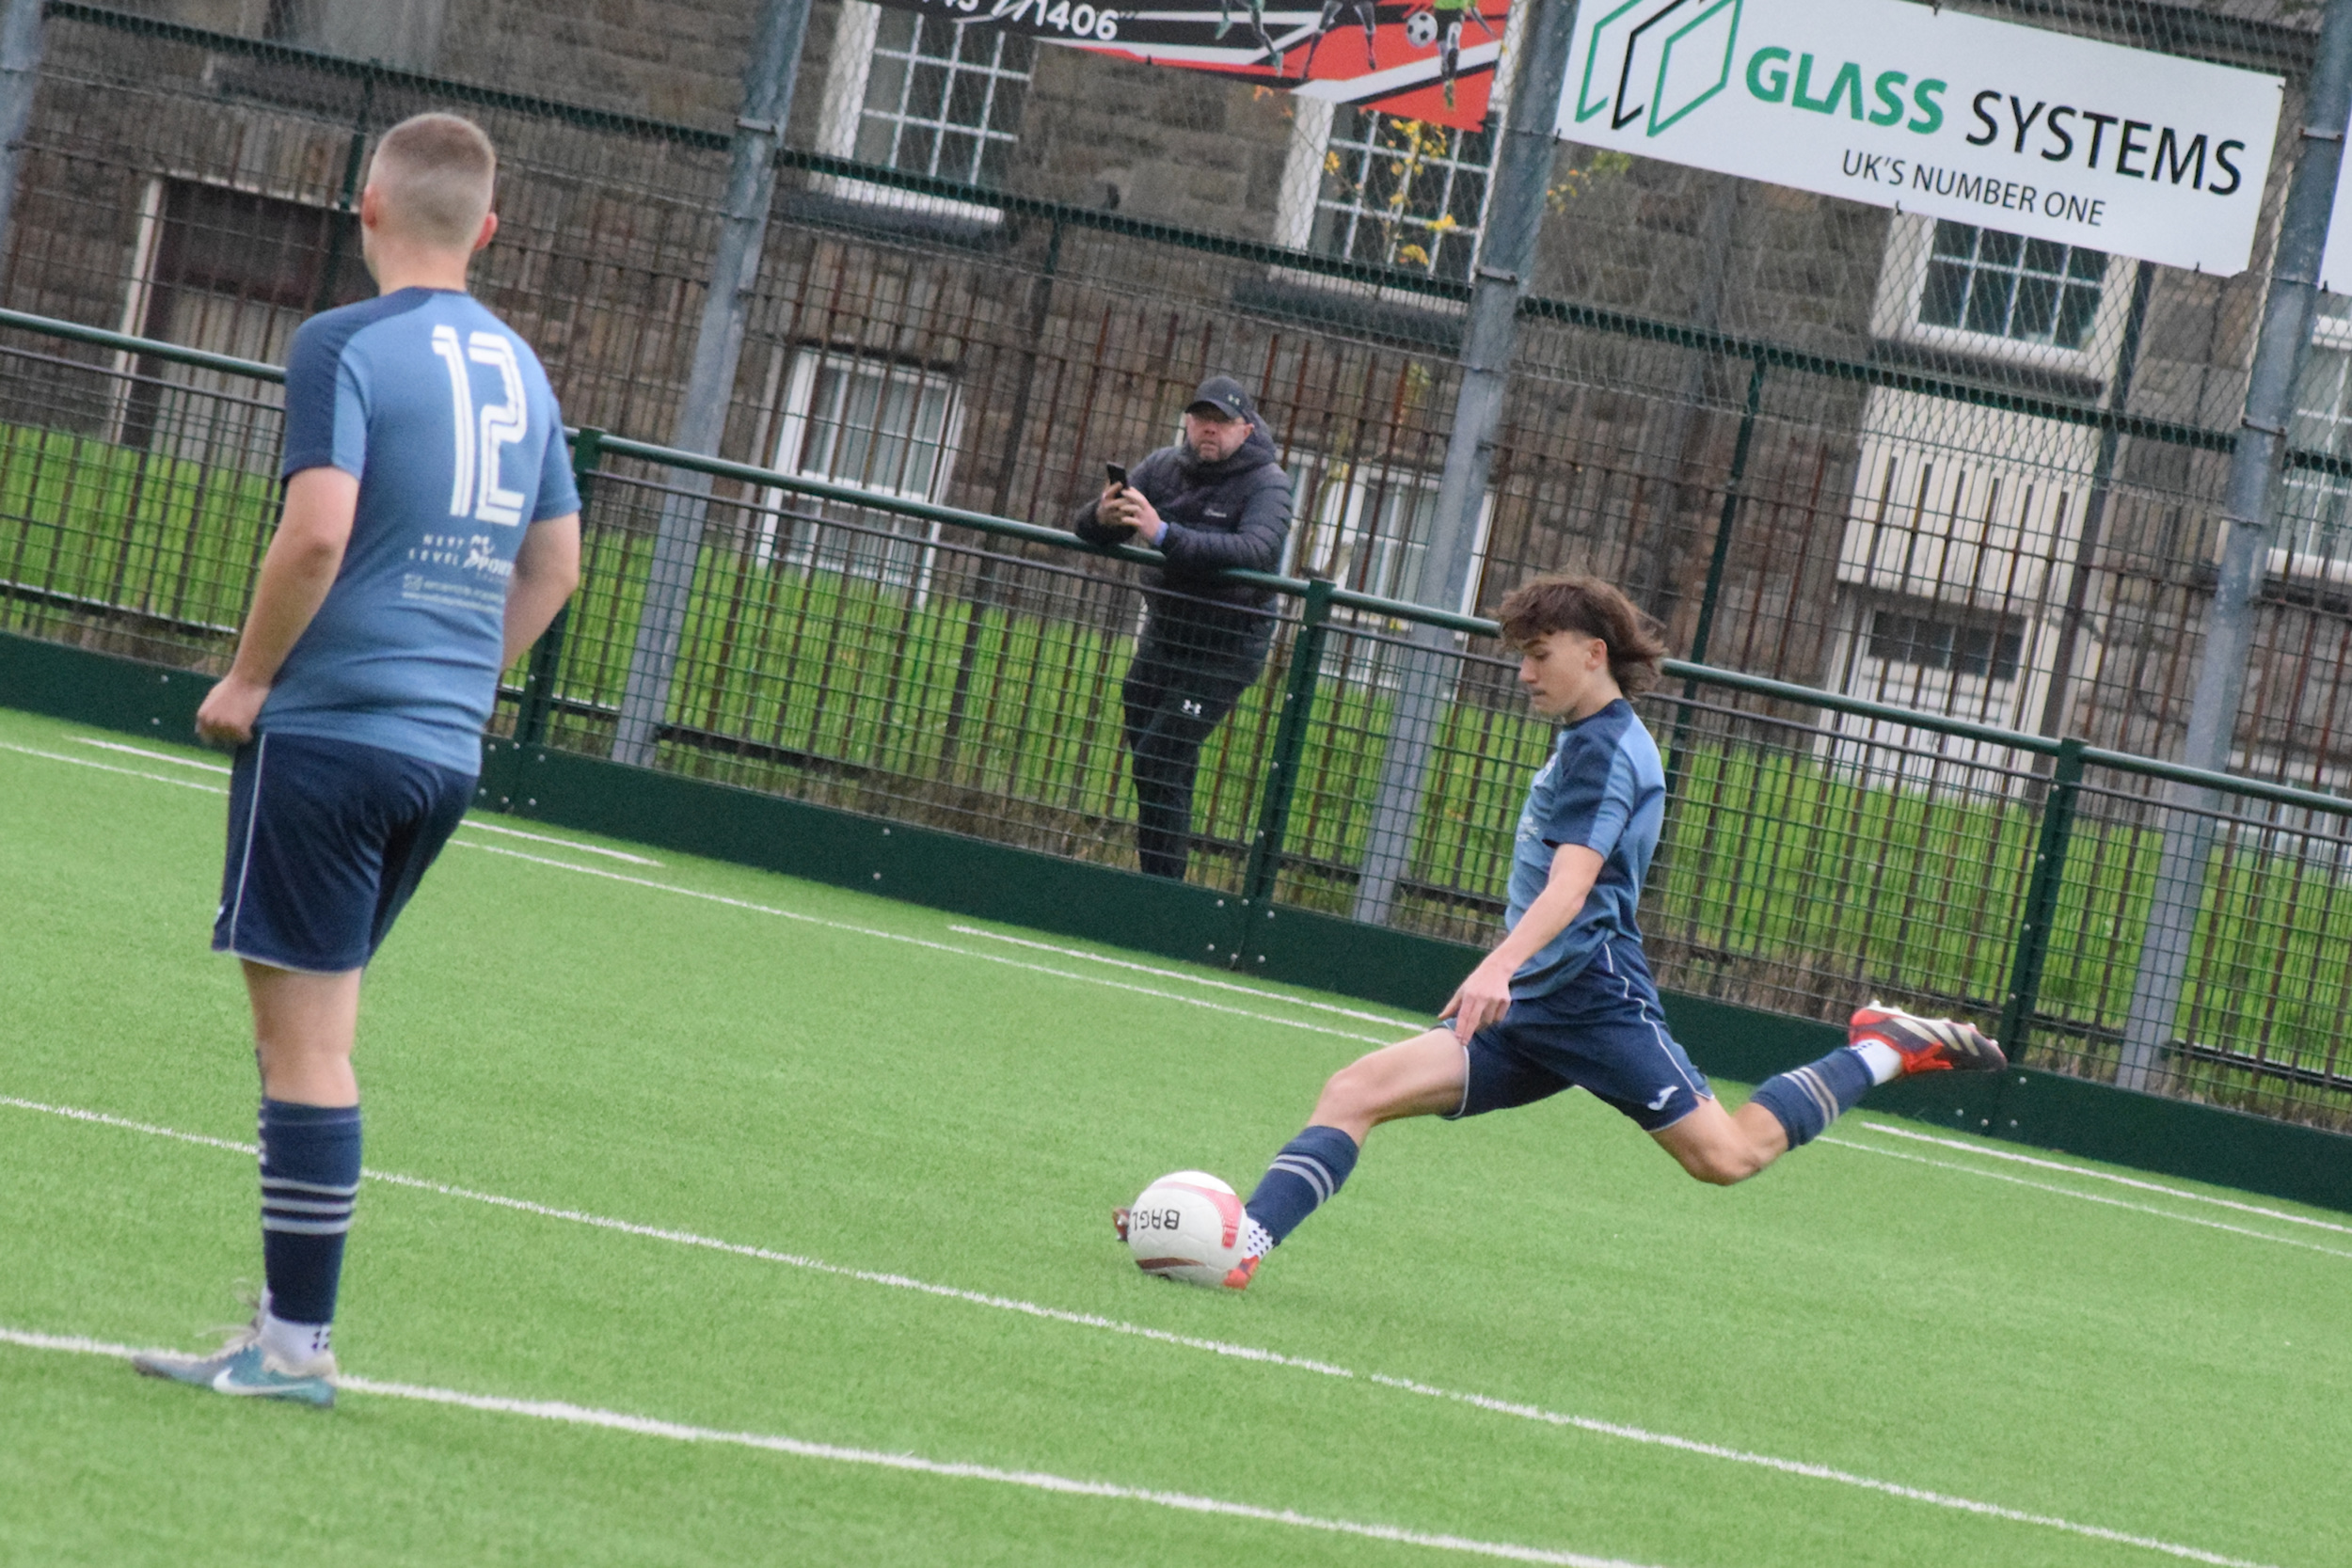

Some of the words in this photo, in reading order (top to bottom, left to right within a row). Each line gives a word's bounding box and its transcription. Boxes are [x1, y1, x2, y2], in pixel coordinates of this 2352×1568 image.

[1746, 46, 1947, 135] GLASS
[1965, 90, 2246, 196] SYSTEMS
[1843, 150, 1905, 185] UK'S
[1913, 165, 2038, 213] NUMBER
[2044, 192, 2106, 226] ONE
[431, 325, 527, 527] 12
